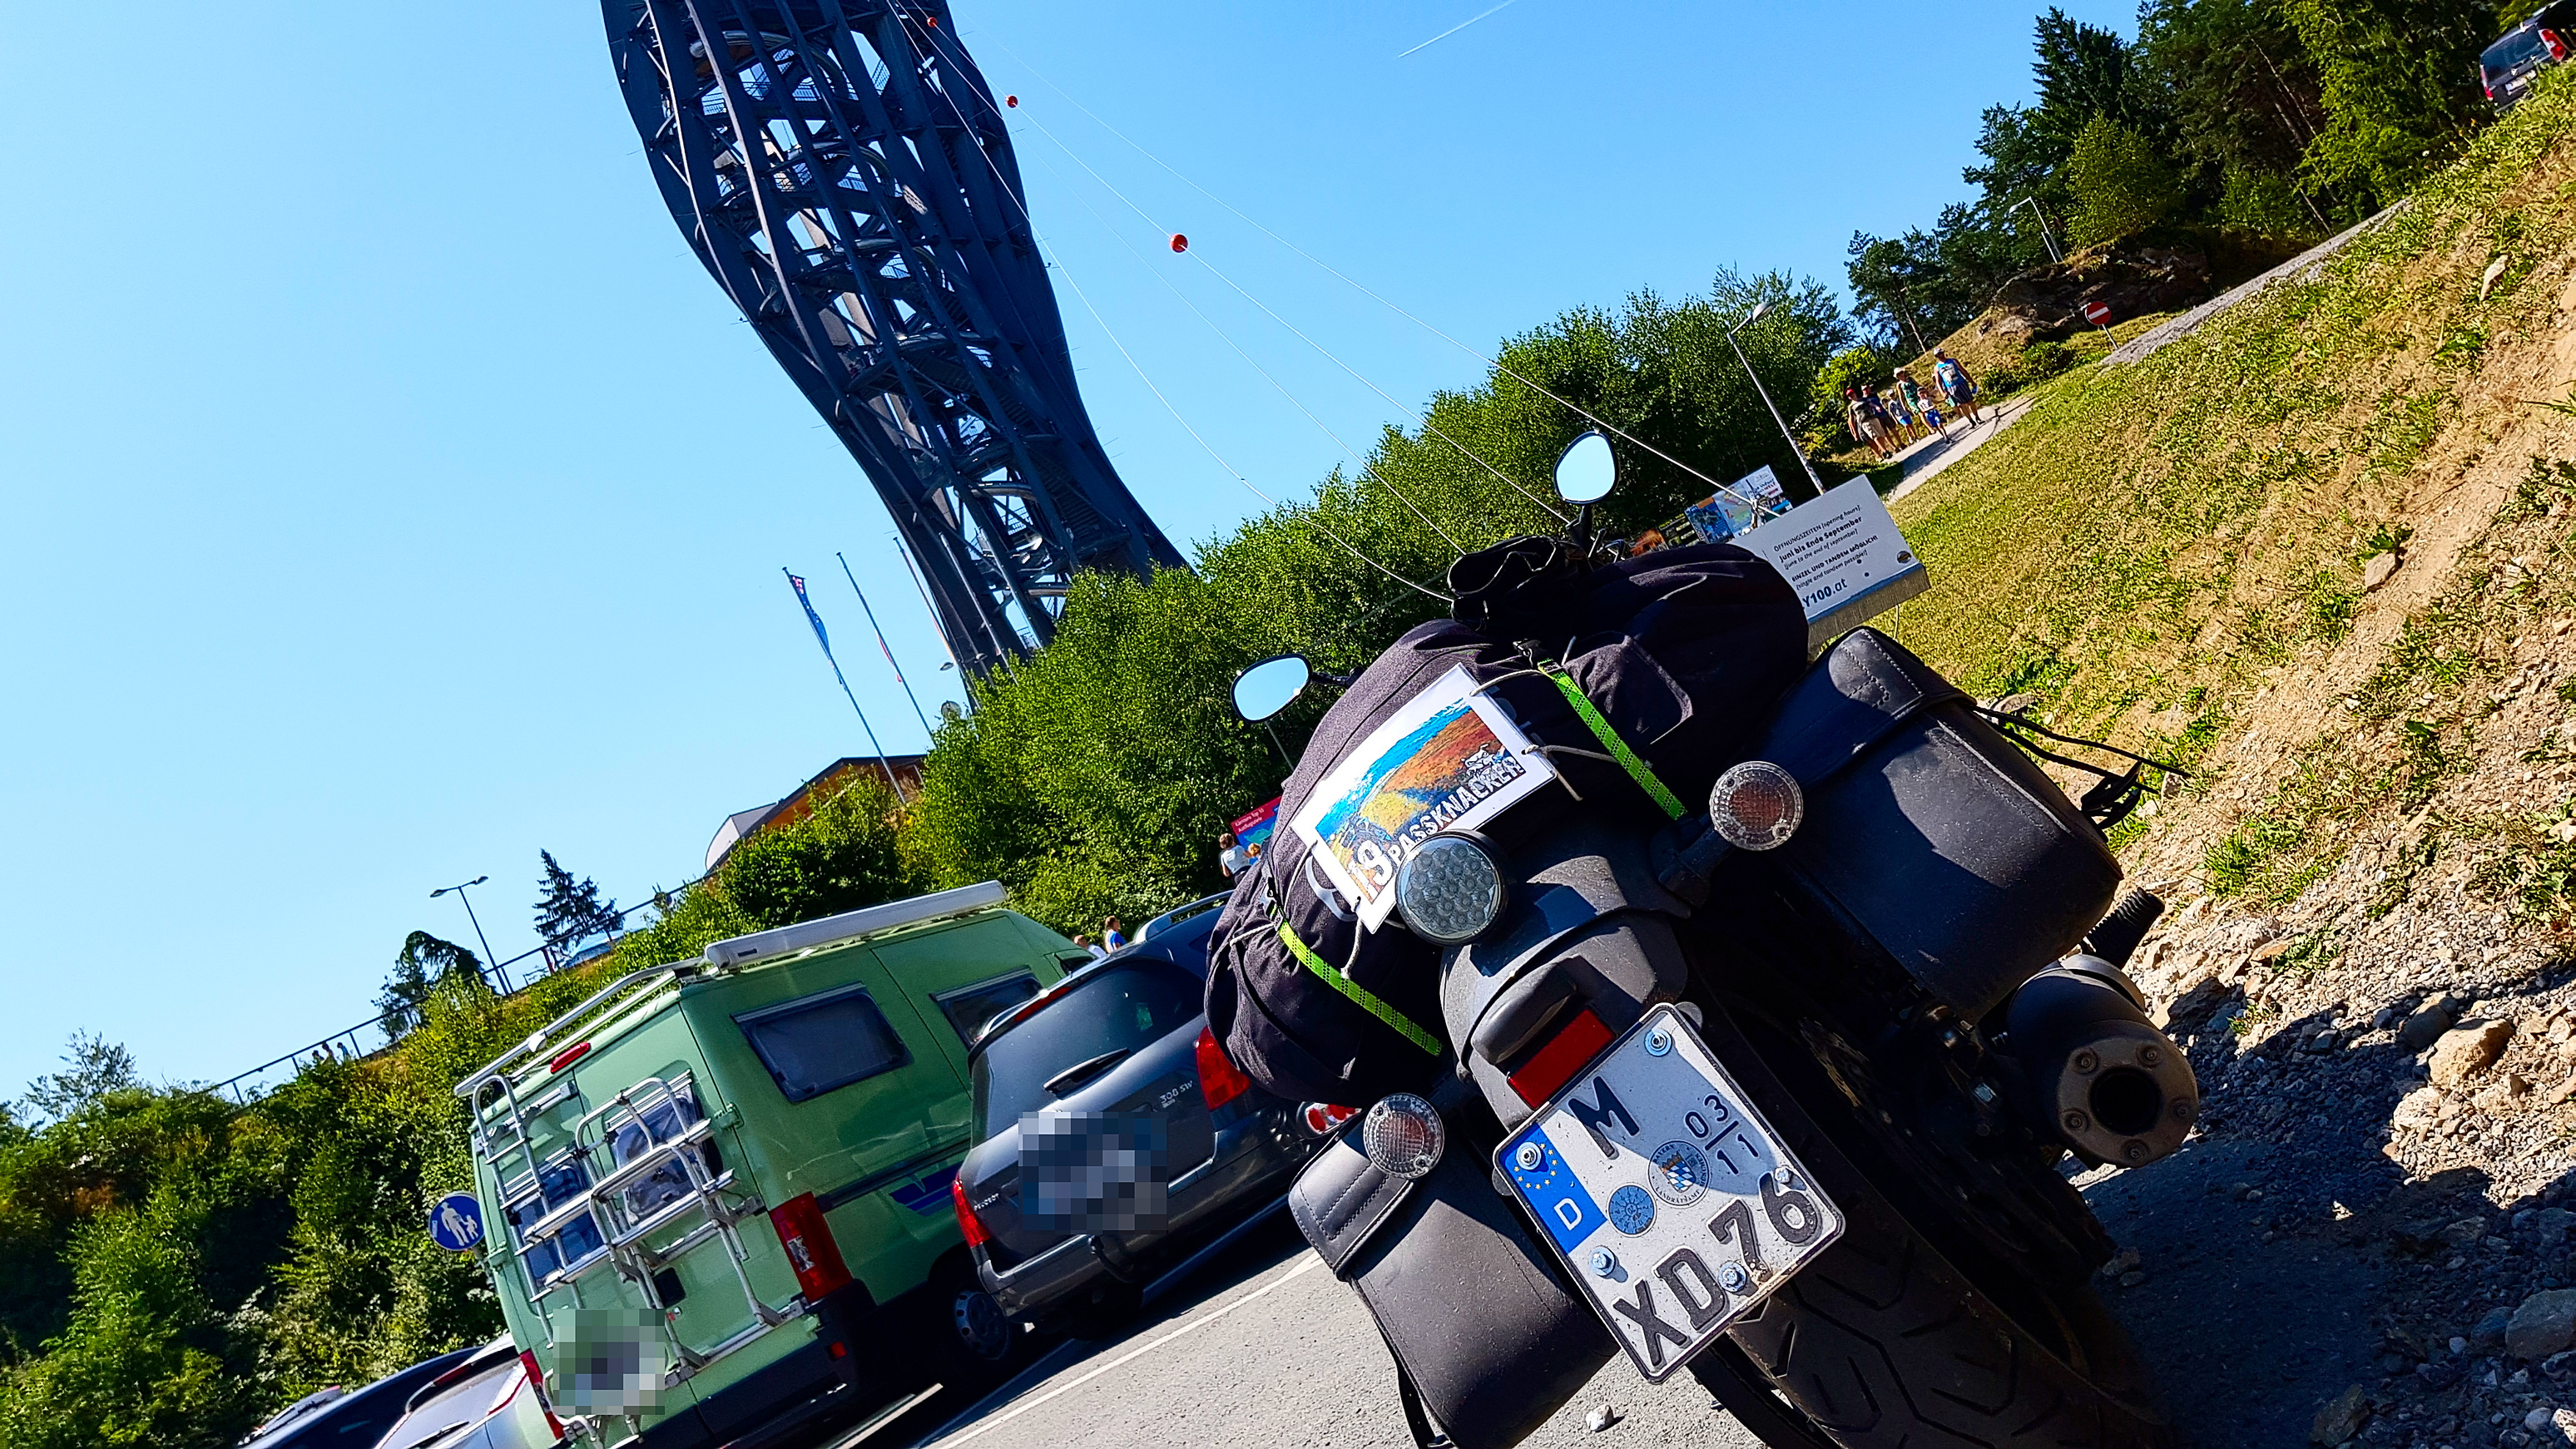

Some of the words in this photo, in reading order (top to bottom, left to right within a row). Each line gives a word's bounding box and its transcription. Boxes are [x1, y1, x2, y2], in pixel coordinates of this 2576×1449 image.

[1773, 524, 1821, 551] ÖFFNUNGSZEITEN
[1779, 549, 1795, 563] Juni
[1795, 545, 1806, 555] bis
[1806, 536, 1824, 548] Ende
[1824, 517, 1862, 539] September
[1791, 569, 1811, 582] EINZEL
[1811, 561, 1825, 571] UND
[1825, 550, 1849, 565] TANDEM
[1824, 563, 1844, 576] tandem
[1388, 756, 1524, 866] PASSKNACKER
[1568, 1076, 1640, 1160] M
[1685, 1095, 1730, 1140] 03
[1717, 1133, 1759, 1175] 11
[1553, 1198, 1582, 1231] D
[1612, 1245, 1730, 1367] XD
[1707, 1173, 1824, 1284] 76
